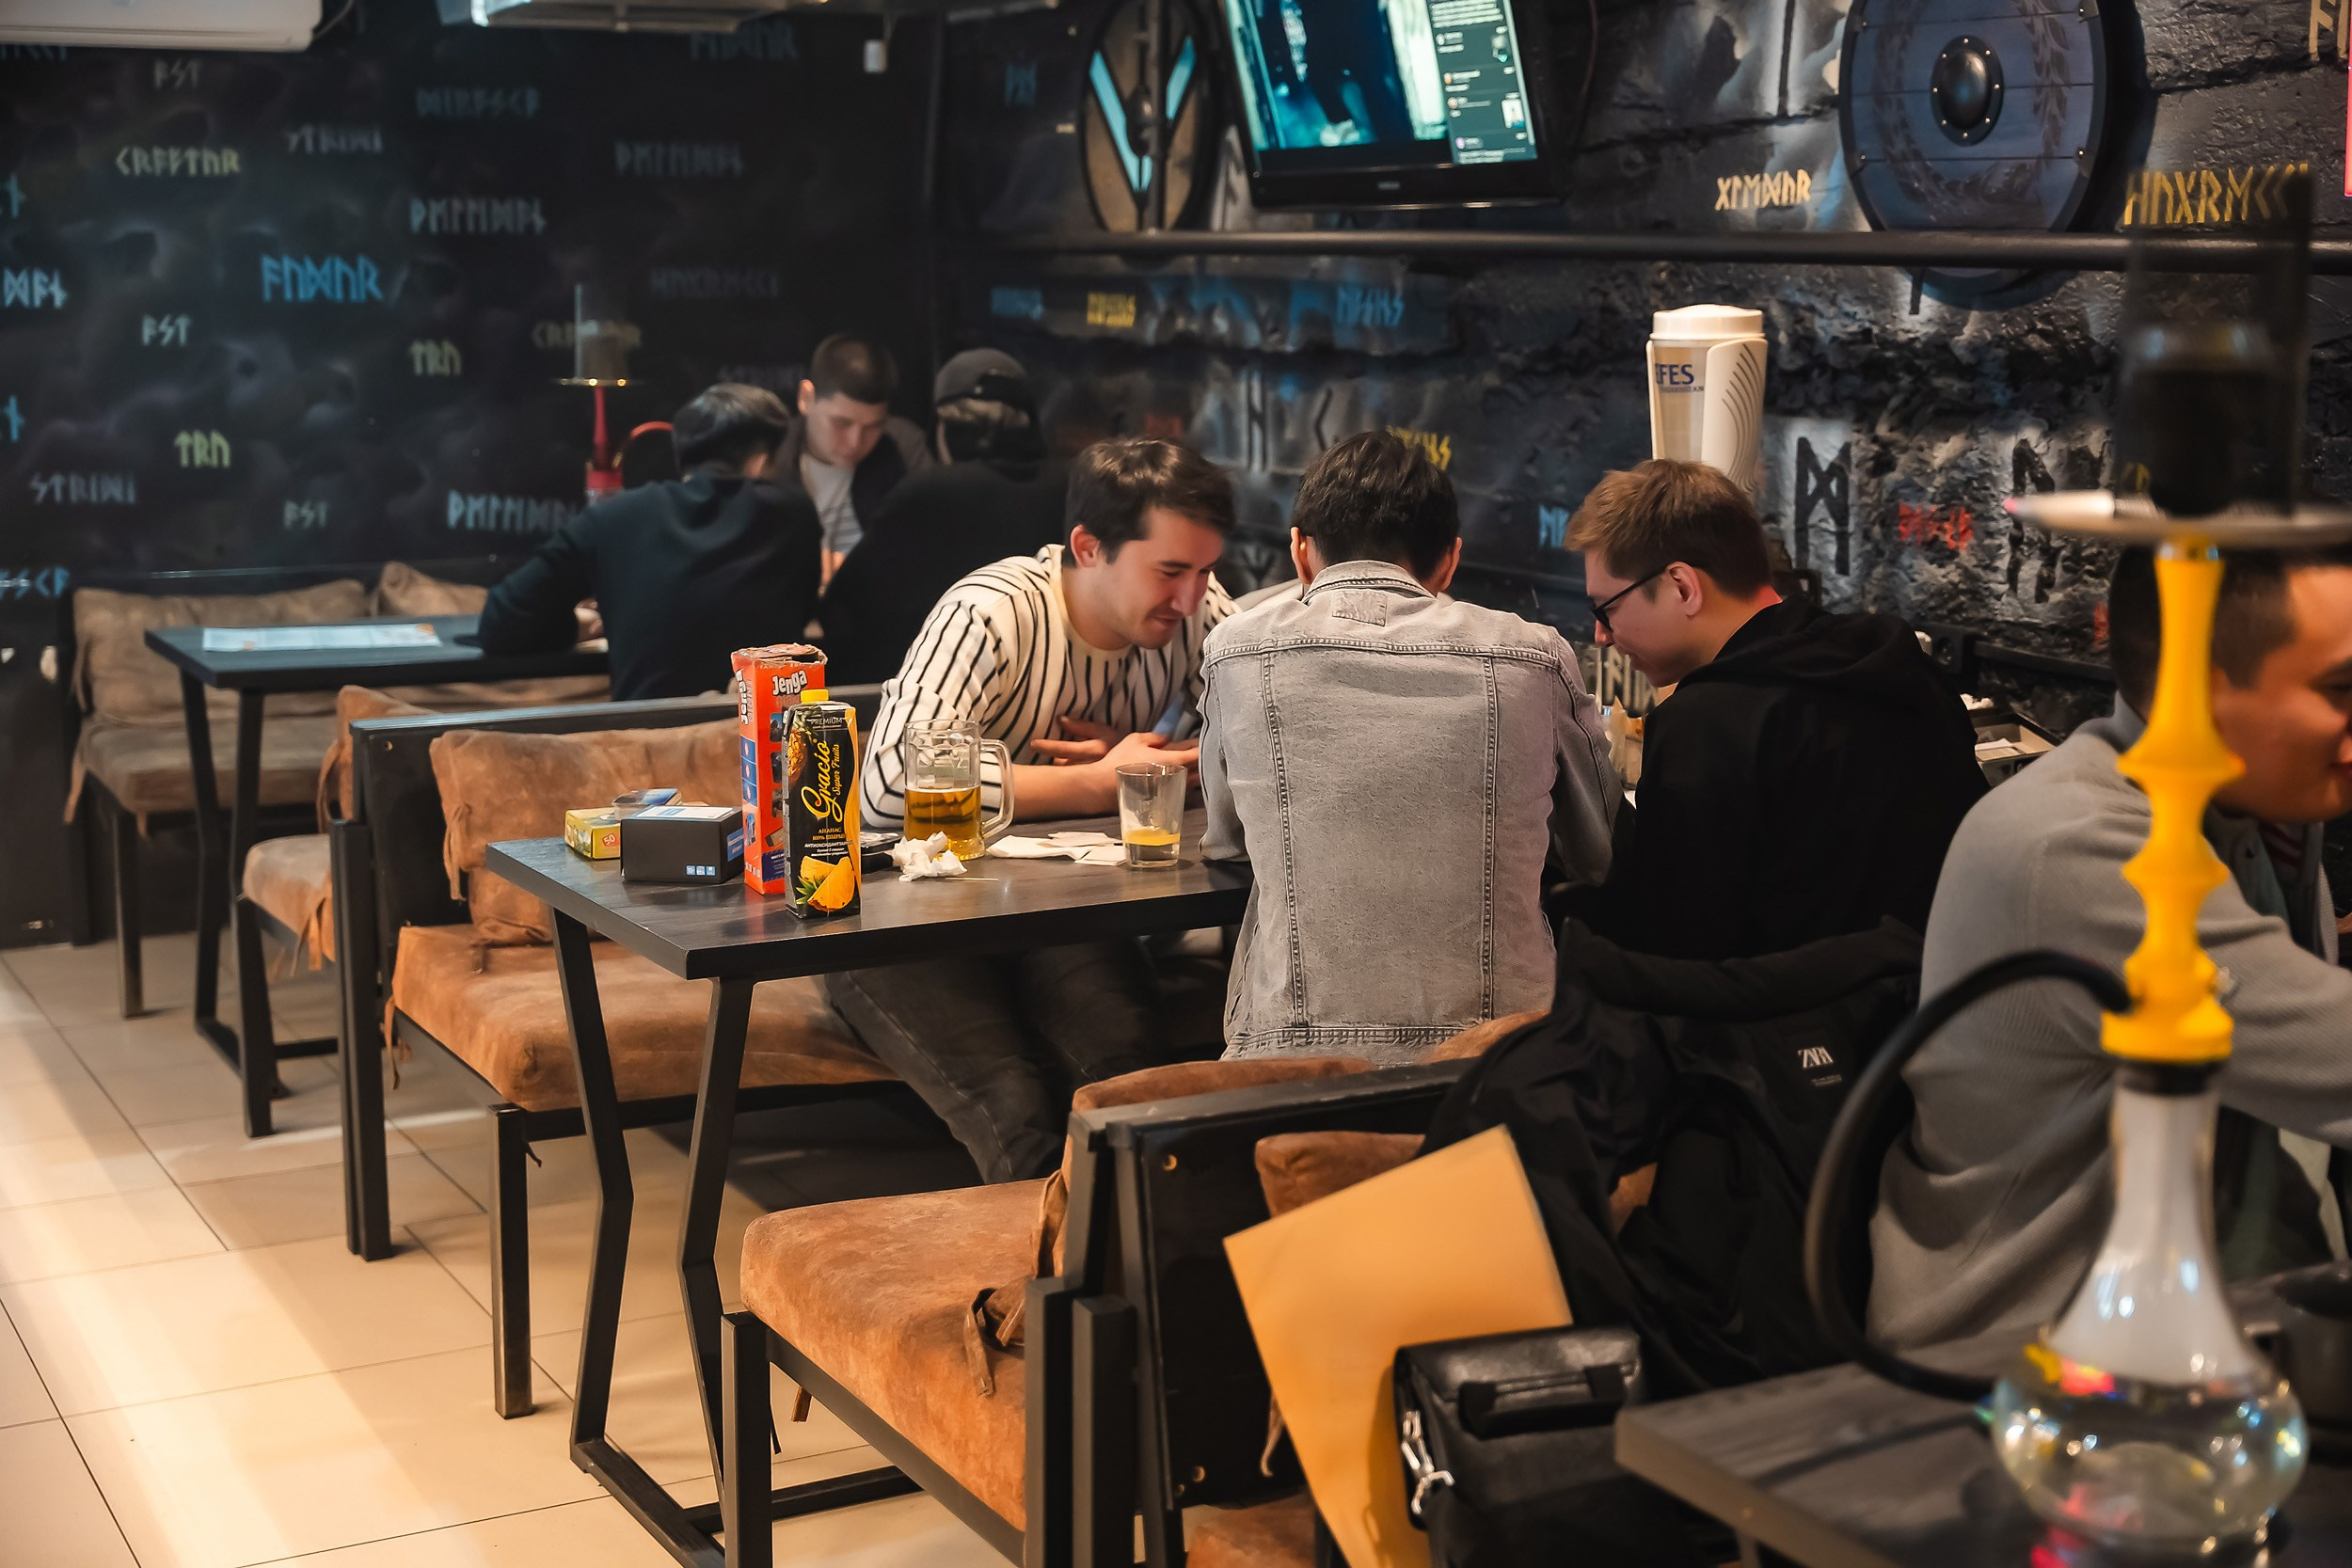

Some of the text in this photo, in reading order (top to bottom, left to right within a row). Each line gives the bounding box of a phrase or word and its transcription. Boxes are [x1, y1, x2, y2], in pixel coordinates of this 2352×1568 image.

[772, 670, 808, 695] Jenga
[810, 716, 843, 725] PREMIUM
[801, 740, 844, 823] Gracio
[830, 743, 843, 796] Super Fruits
[603, 833, 616, 846] 50
